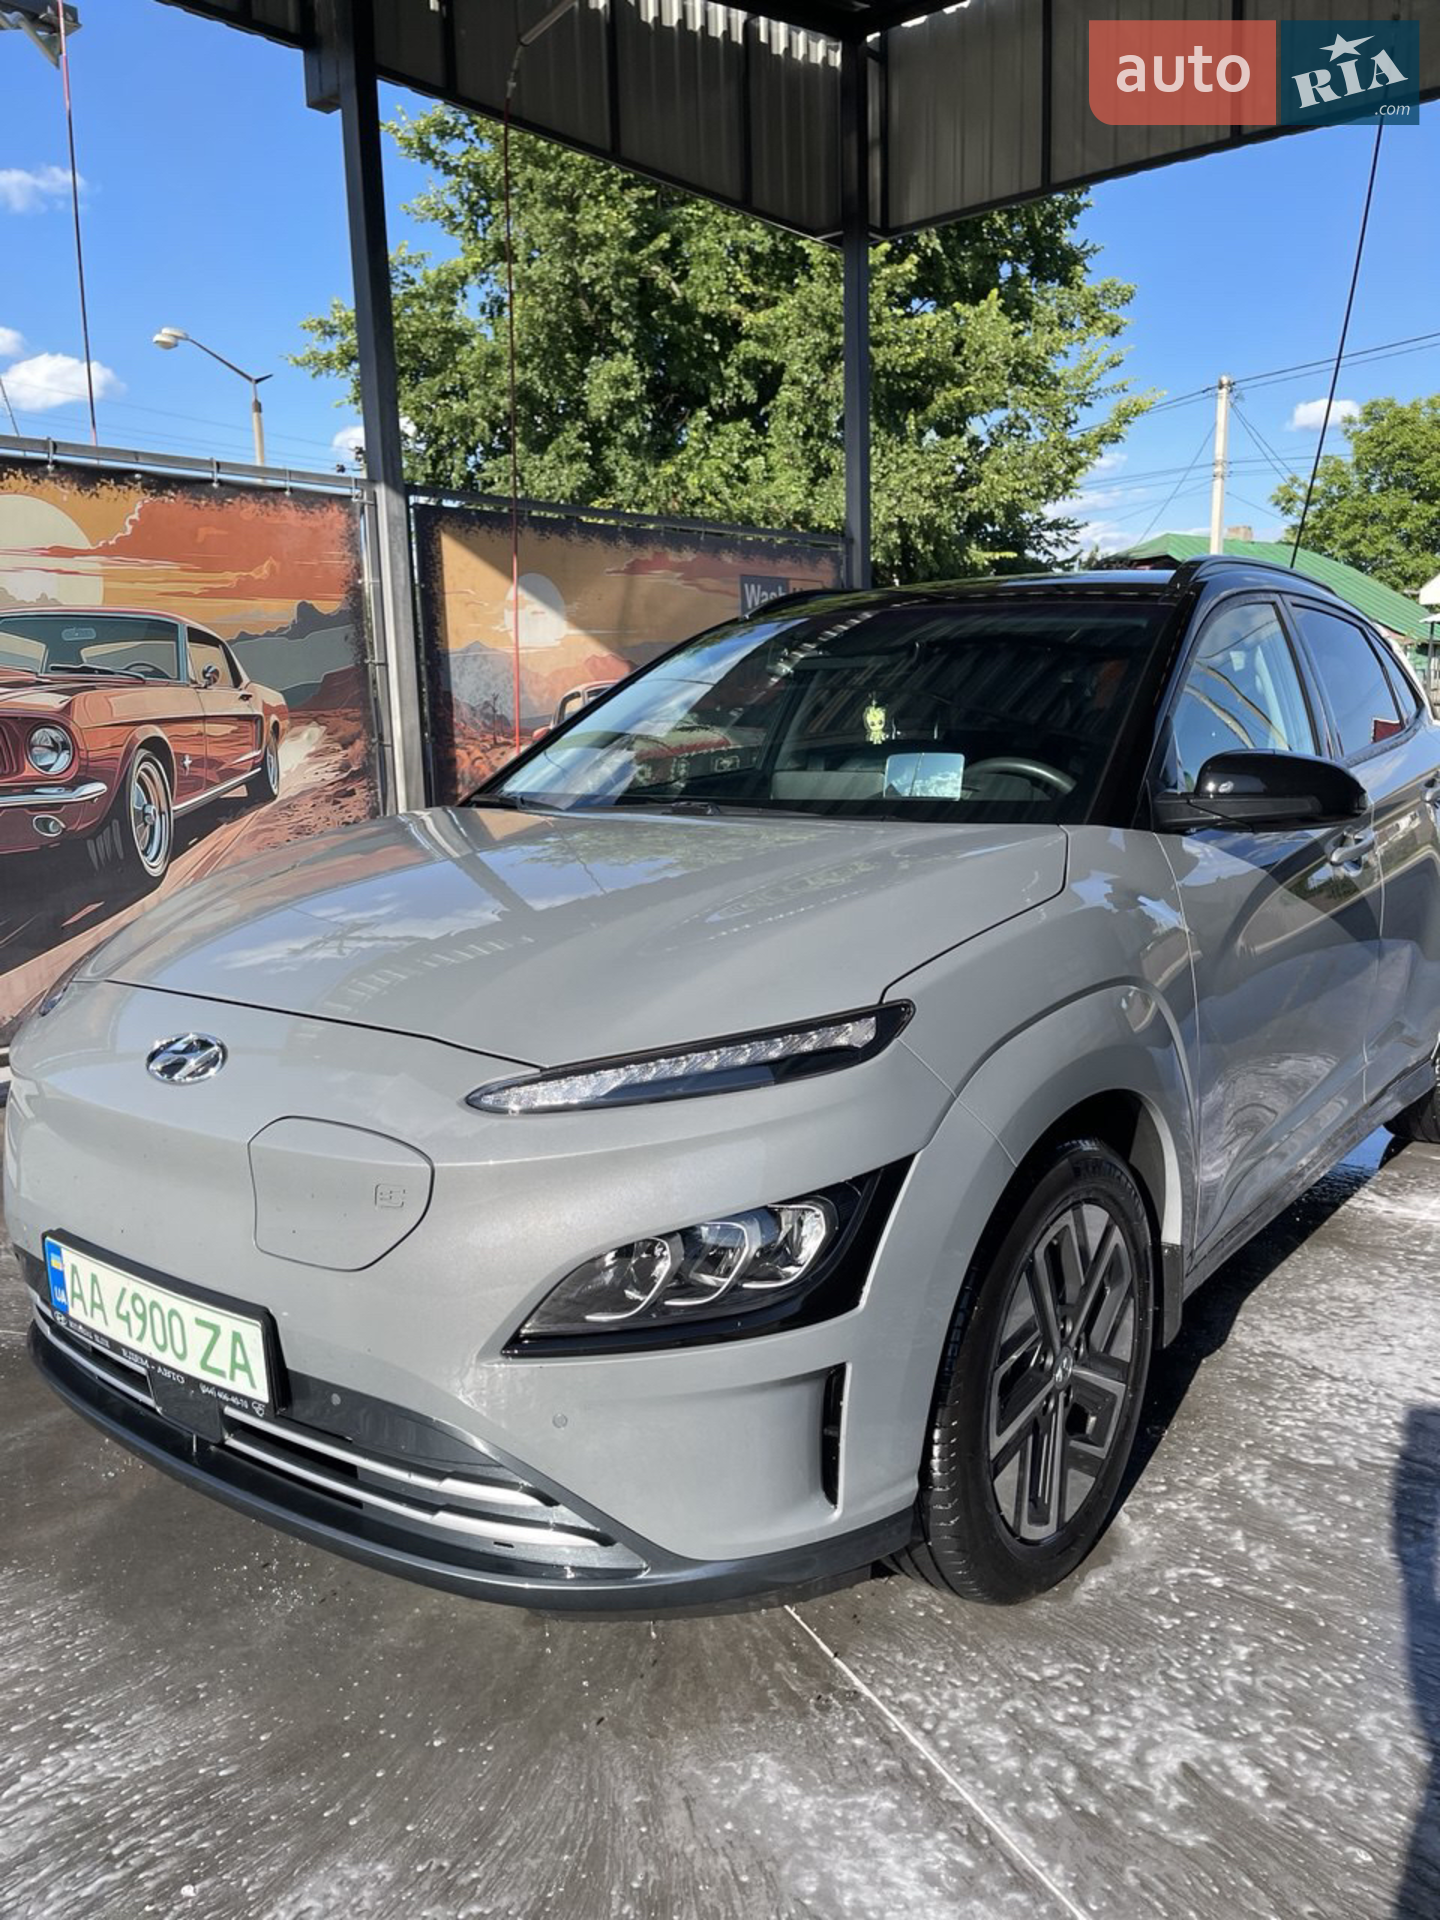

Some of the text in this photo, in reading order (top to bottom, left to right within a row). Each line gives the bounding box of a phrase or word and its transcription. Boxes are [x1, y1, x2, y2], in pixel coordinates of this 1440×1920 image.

[54, 1287, 68, 1304] UA
[71, 1263, 257, 1389] AA 4900 ZA
